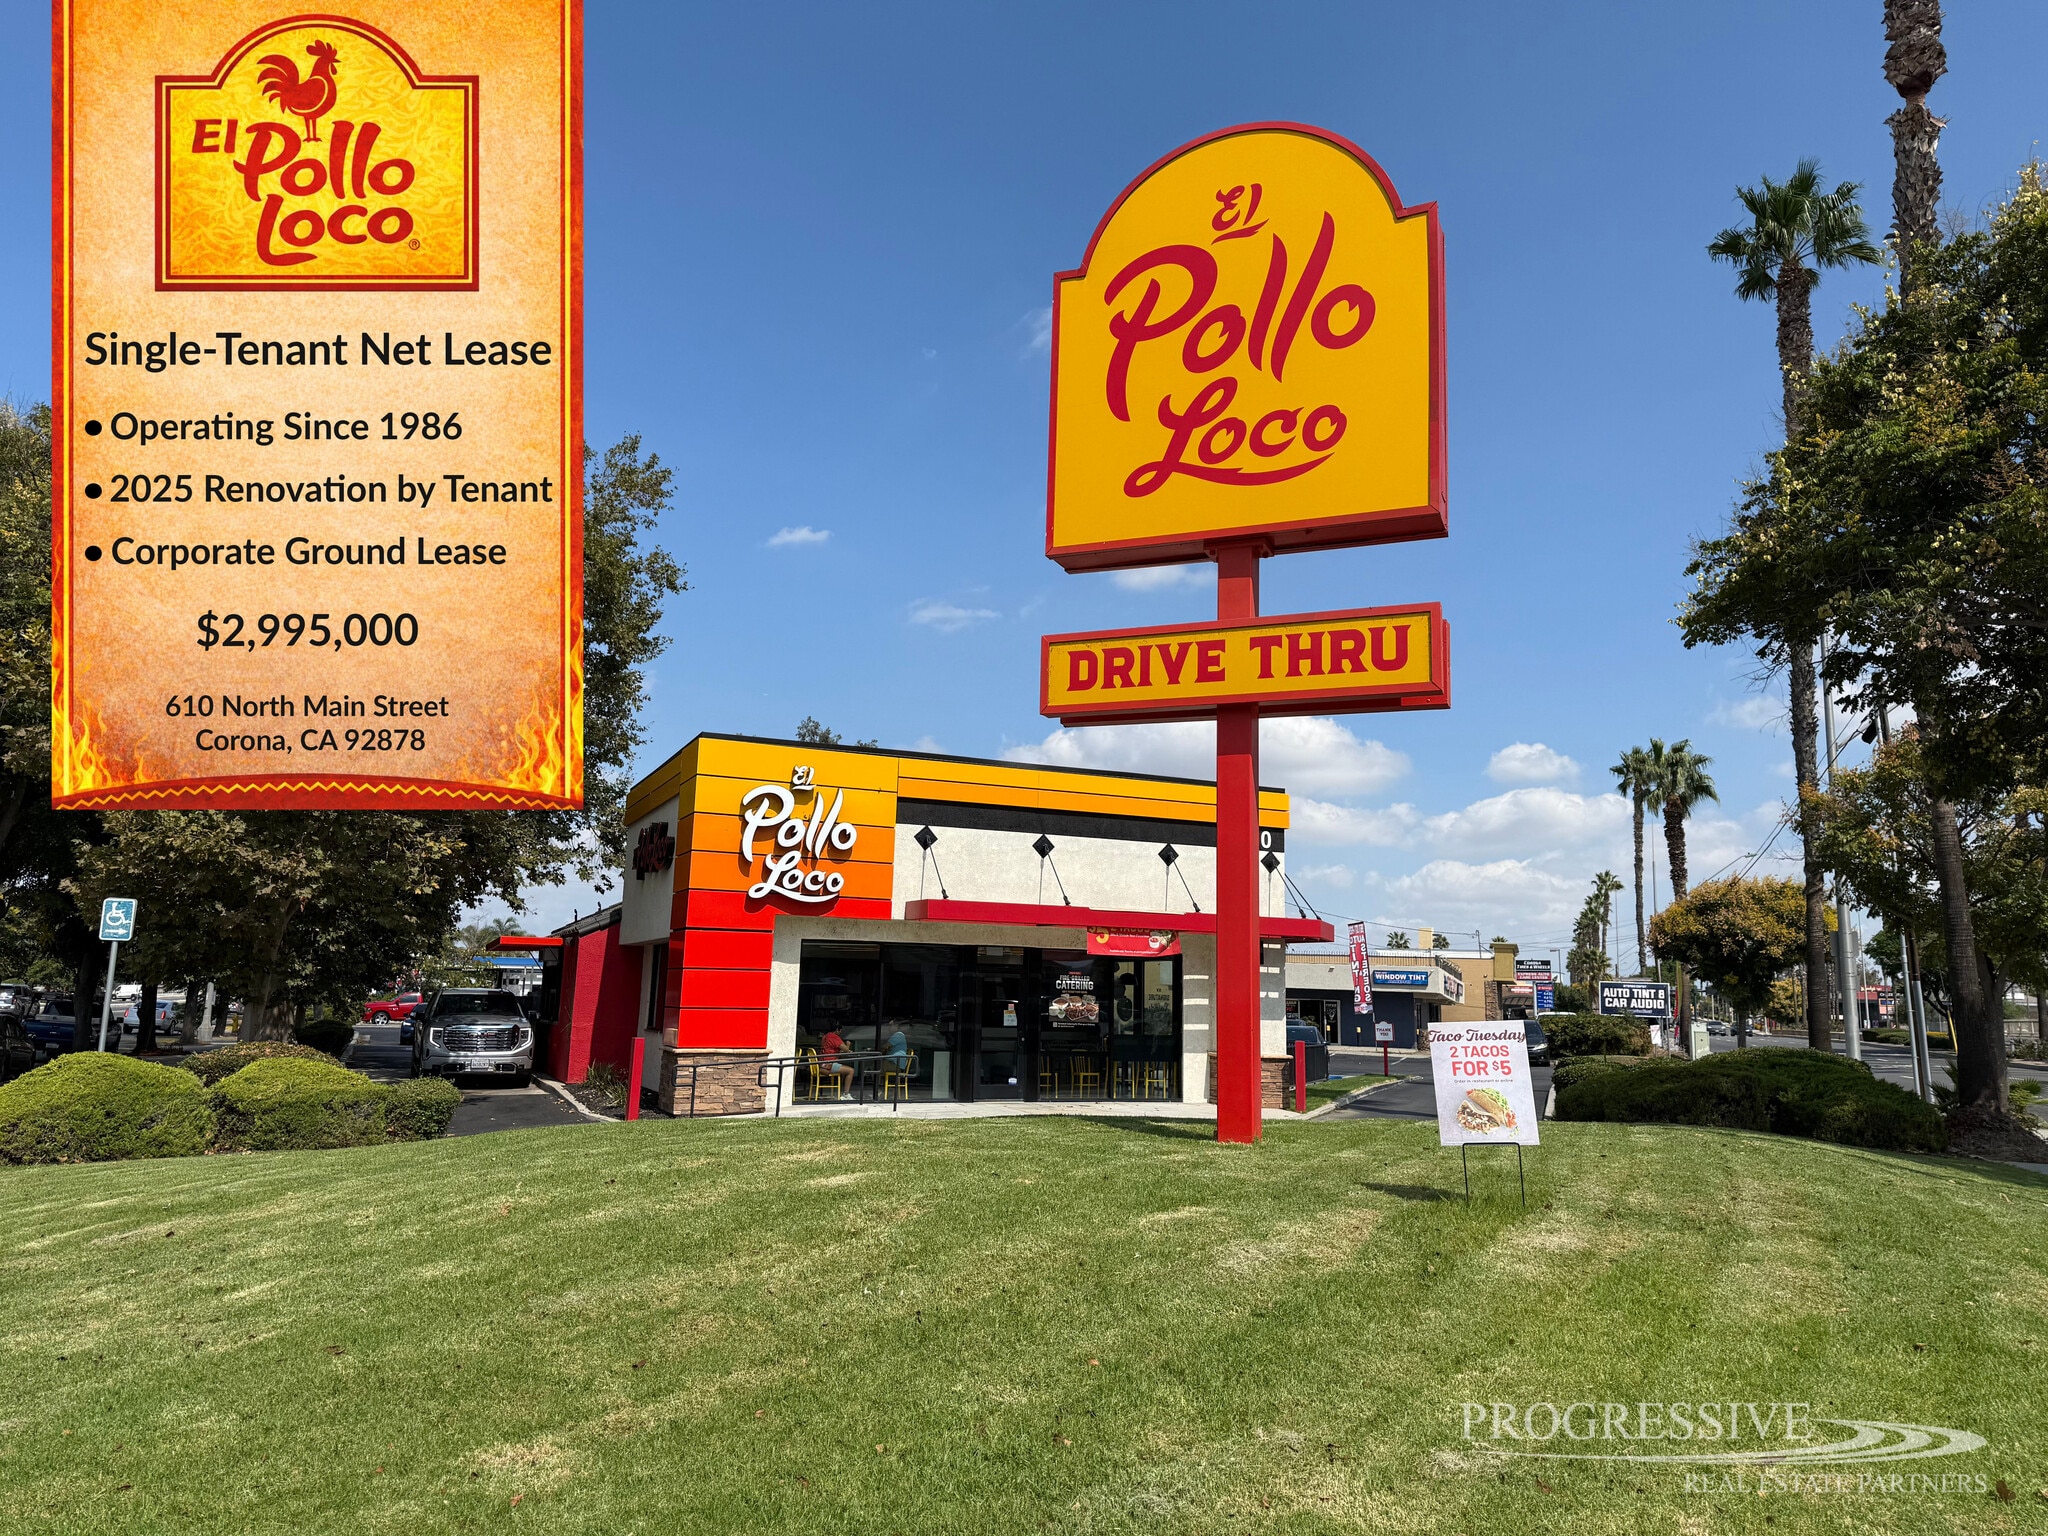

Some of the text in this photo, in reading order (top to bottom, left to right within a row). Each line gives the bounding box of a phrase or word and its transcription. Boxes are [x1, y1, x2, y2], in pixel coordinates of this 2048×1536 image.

[1103, 210, 1376, 423] Pollo
[1122, 376, 1348, 498] Loco
[1066, 624, 1412, 692] DRIVE THRU
[742, 784, 858, 864] Pollo
[748, 850, 845, 903] Loco
[1056, 980, 1094, 990] CATERING
[1603, 988, 1630, 998] AUTO
[1632, 989, 1656, 999] TINT
[1605, 998, 1665, 1009] CAR AUDIO
[1428, 1028, 1526, 1043] Taco Tuesday
[1449, 1045, 1510, 1058] 2 TACOS
[1451, 1060, 1512, 1076] FOR $5
